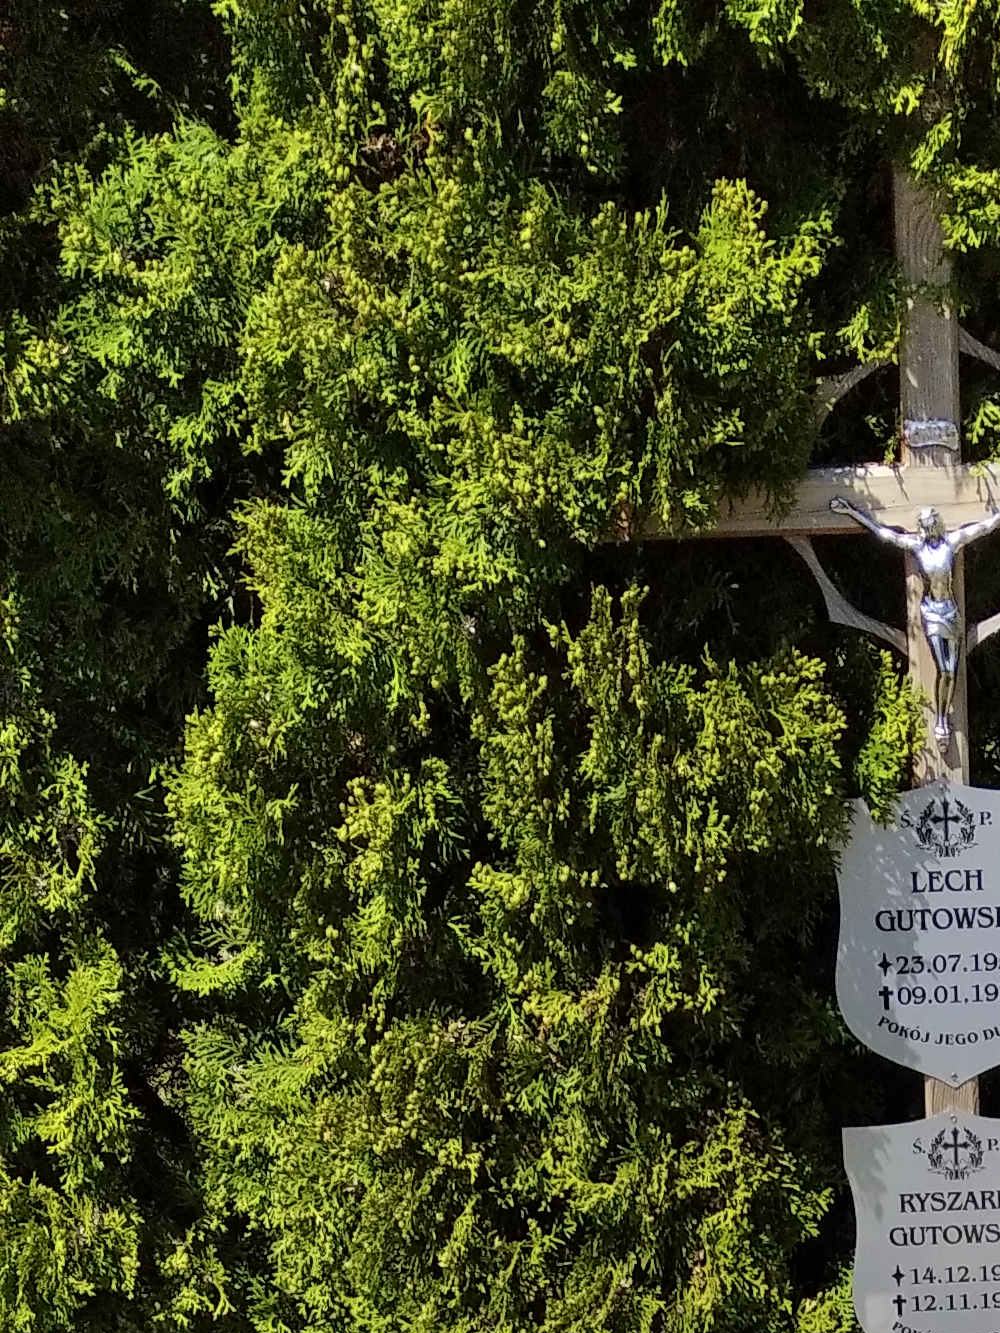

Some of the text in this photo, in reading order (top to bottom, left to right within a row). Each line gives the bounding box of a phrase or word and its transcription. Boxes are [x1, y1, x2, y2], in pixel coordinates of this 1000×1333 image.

[900, 810, 993, 828] Ś. P.
[911, 869, 984, 893] LECH
[877, 1015, 930, 1043] POKÓJ
[935, 1031, 978, 1046] JEGO
[912, 1138, 1000, 1154] Ś. P.
